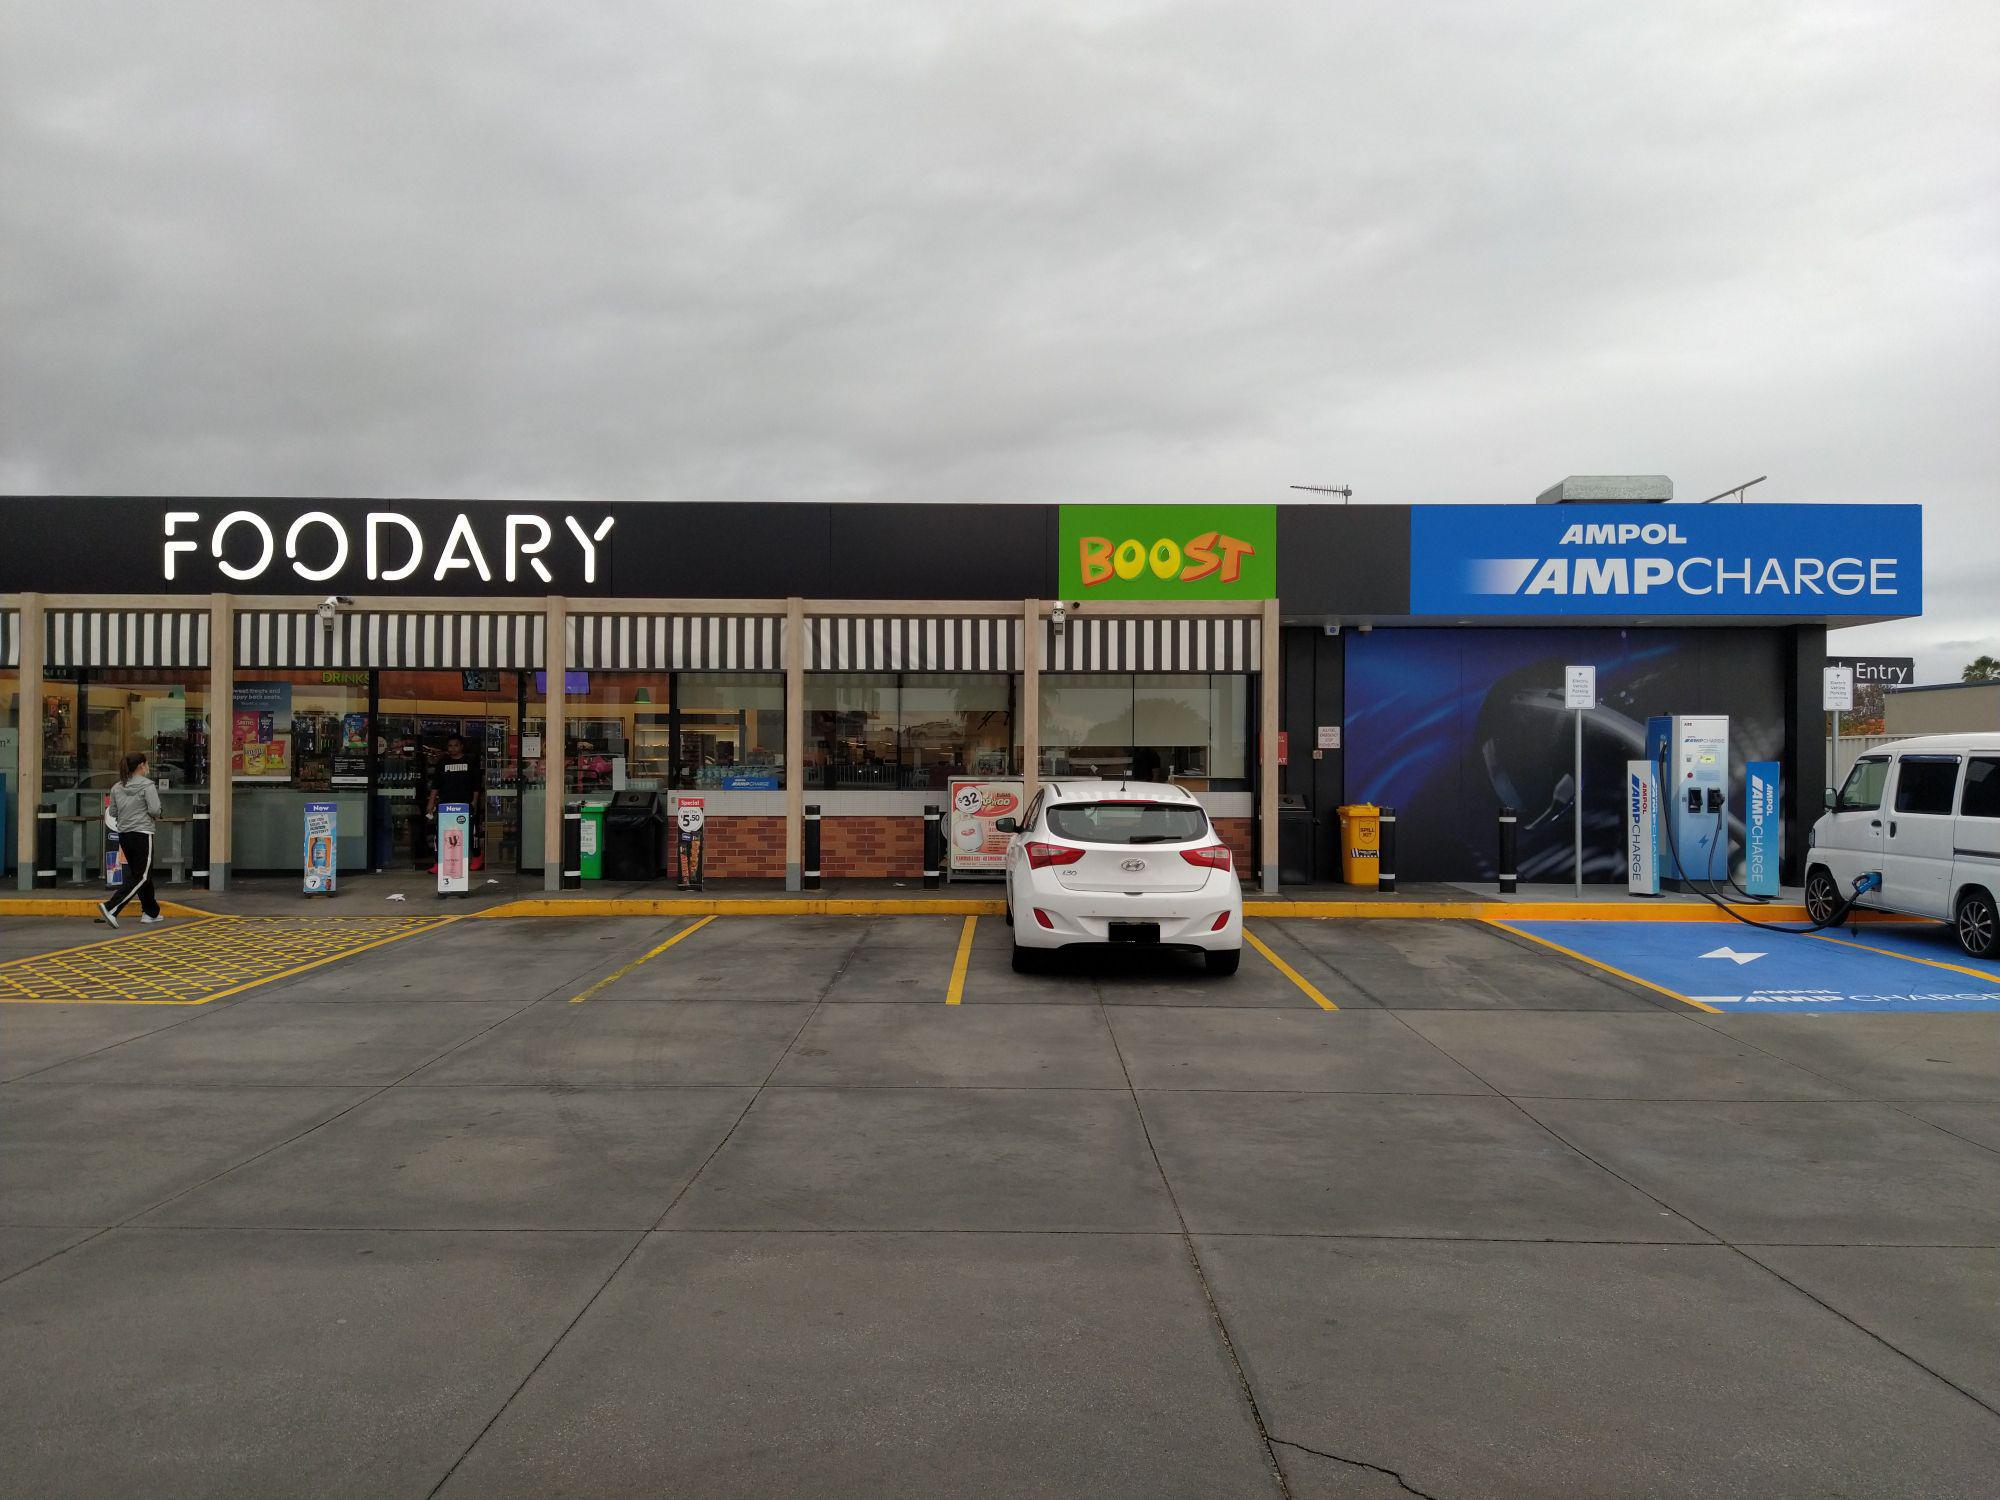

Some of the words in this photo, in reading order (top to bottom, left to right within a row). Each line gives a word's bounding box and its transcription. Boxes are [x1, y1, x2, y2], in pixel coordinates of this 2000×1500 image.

[164, 510, 615, 583] FOODARY
[1558, 523, 1688, 545] AMPOL
[1079, 531, 1255, 587] BOOST
[1523, 557, 1898, 596] AMPCHARGE
[322, 671, 370, 684] DRINKS
[1856, 662, 1907, 684] Entry
[958, 792, 979, 807] $32
[1631, 784, 1641, 881] AMPCHARGE
[1751, 787, 1764, 883] AMPCHARGE
